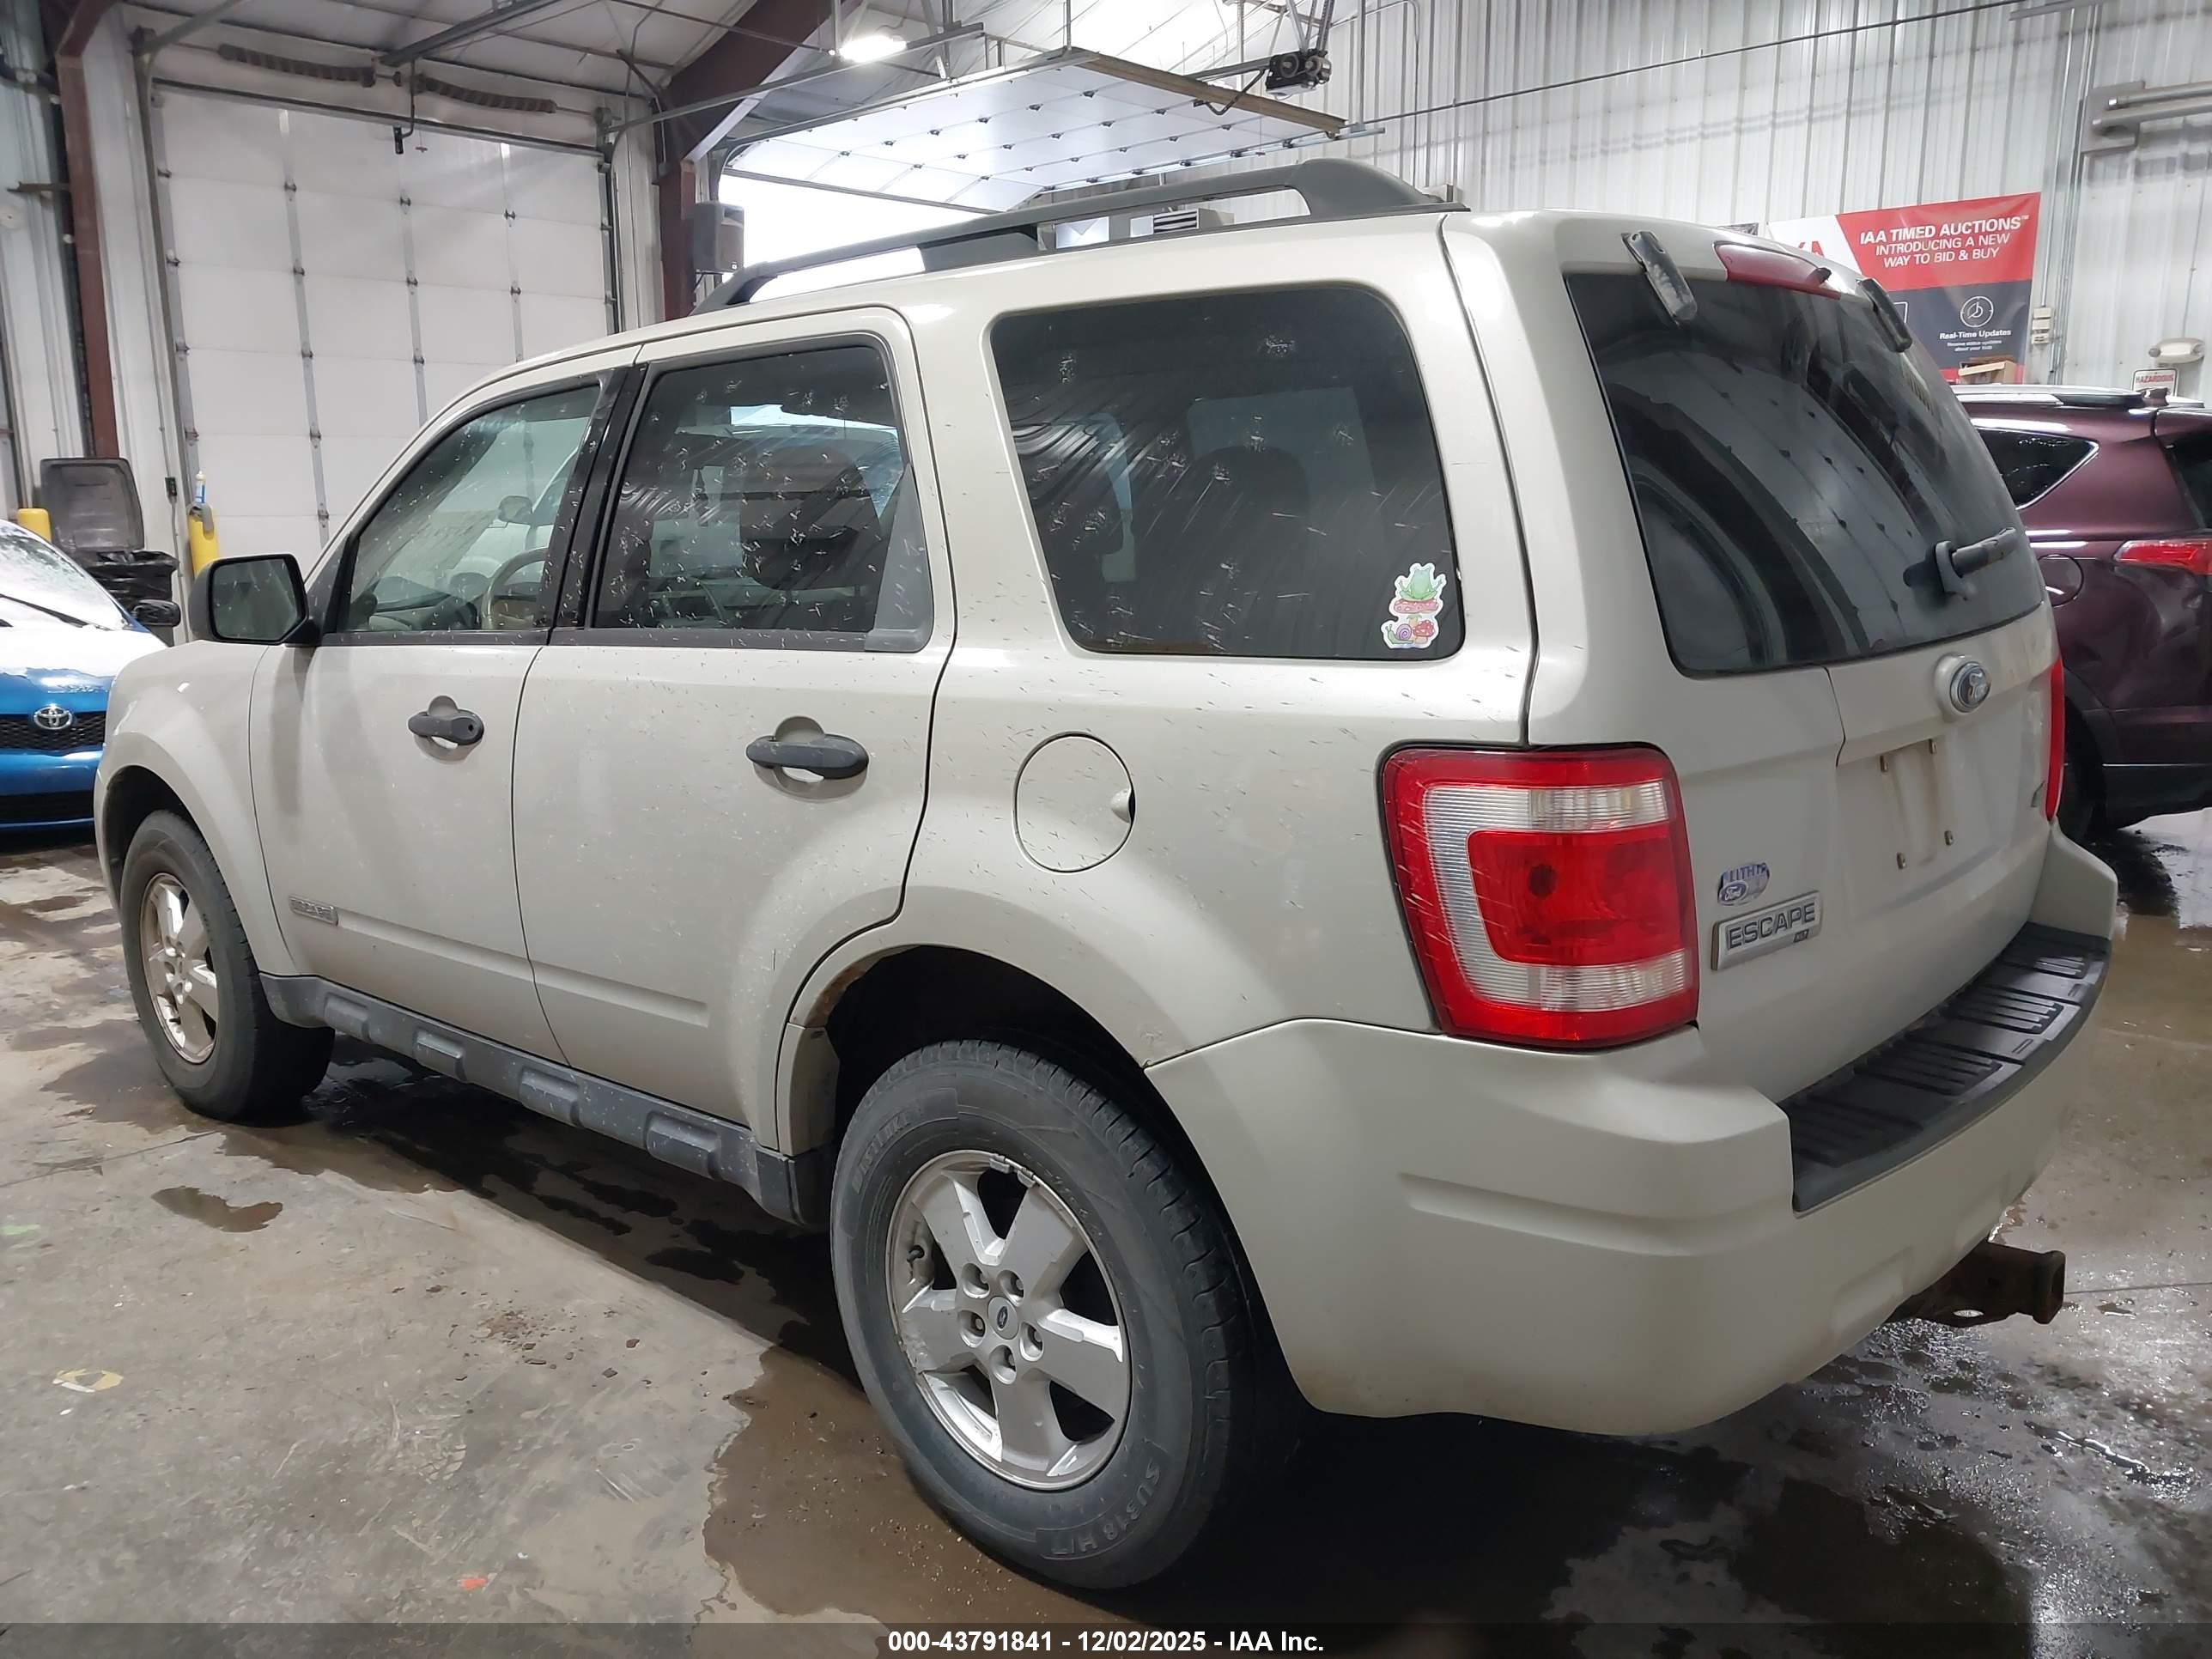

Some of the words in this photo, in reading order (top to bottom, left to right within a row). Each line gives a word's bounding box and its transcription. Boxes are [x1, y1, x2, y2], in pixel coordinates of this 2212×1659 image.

[1860, 229, 1887, 245] IAA
[1890, 225, 1936, 242] TIMED
[1875, 237, 1962, 256] INTRODUCING
[1965, 236, 1975, 247] A
[1978, 232, 2011, 246] NEW
[1883, 254, 1911, 268] WAY
[1914, 252, 1930, 265] TO
[1934, 251, 1955, 263] BID
[1958, 249, 1969, 261] &
[1972, 246, 1999, 259] BUY
[1939, 331, 1978, 340] Real-Time
[1978, 330, 2012, 338] Updates
[1729, 902, 1815, 949] ESCAPE
